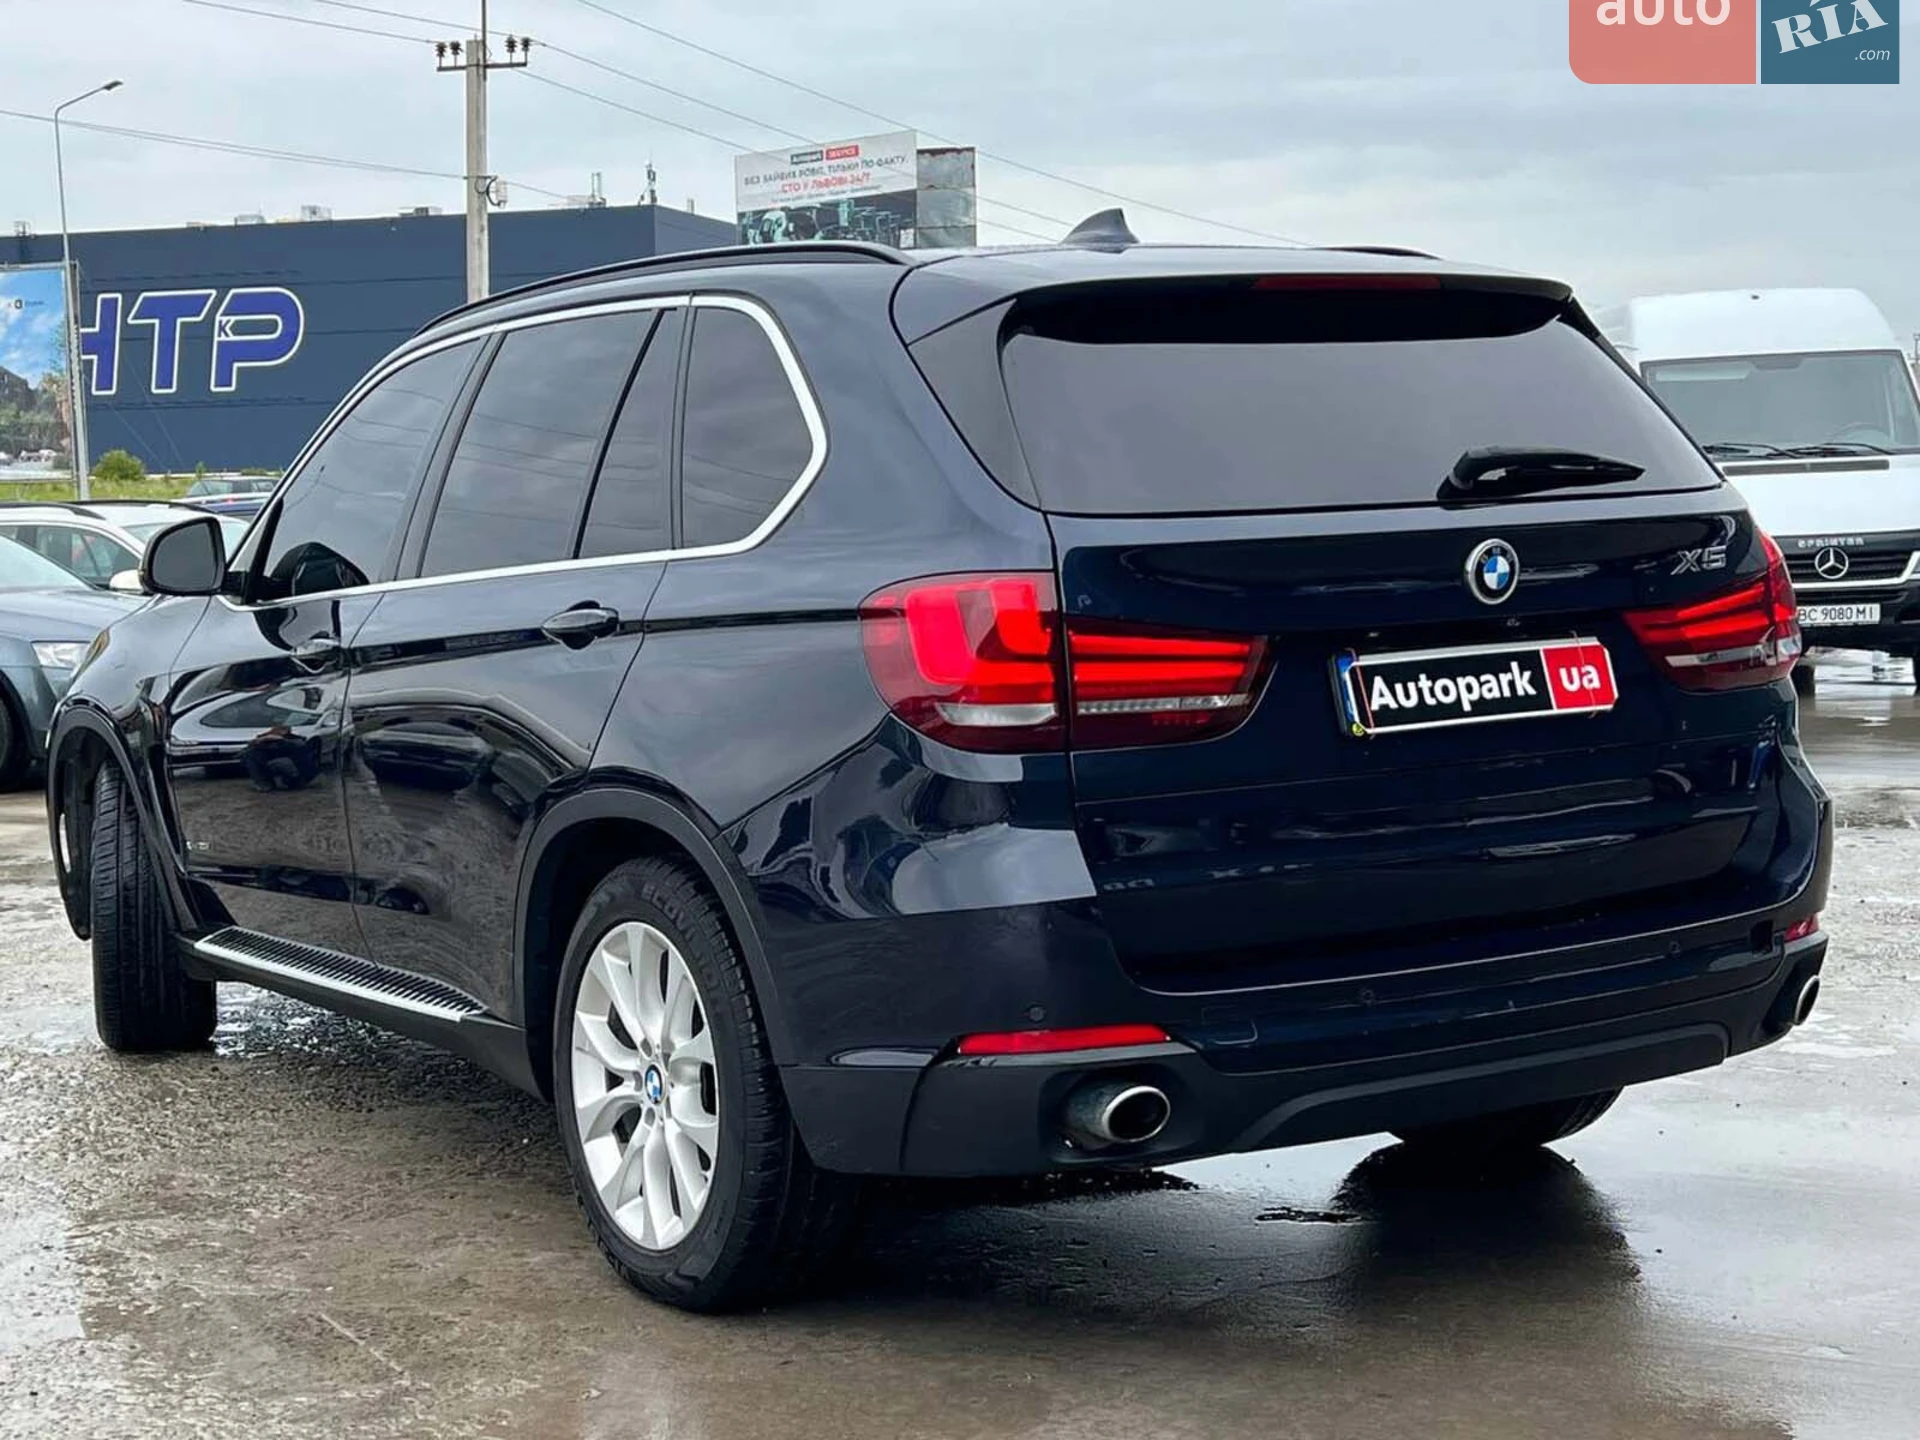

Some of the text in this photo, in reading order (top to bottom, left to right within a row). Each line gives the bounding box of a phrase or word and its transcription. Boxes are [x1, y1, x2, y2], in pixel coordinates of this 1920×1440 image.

[781, 182, 801, 193] СТО
[1670, 545, 1728, 575] X5
[1821, 607, 1854, 621] 9080
[1370, 661, 1600, 712] Autopark ua
